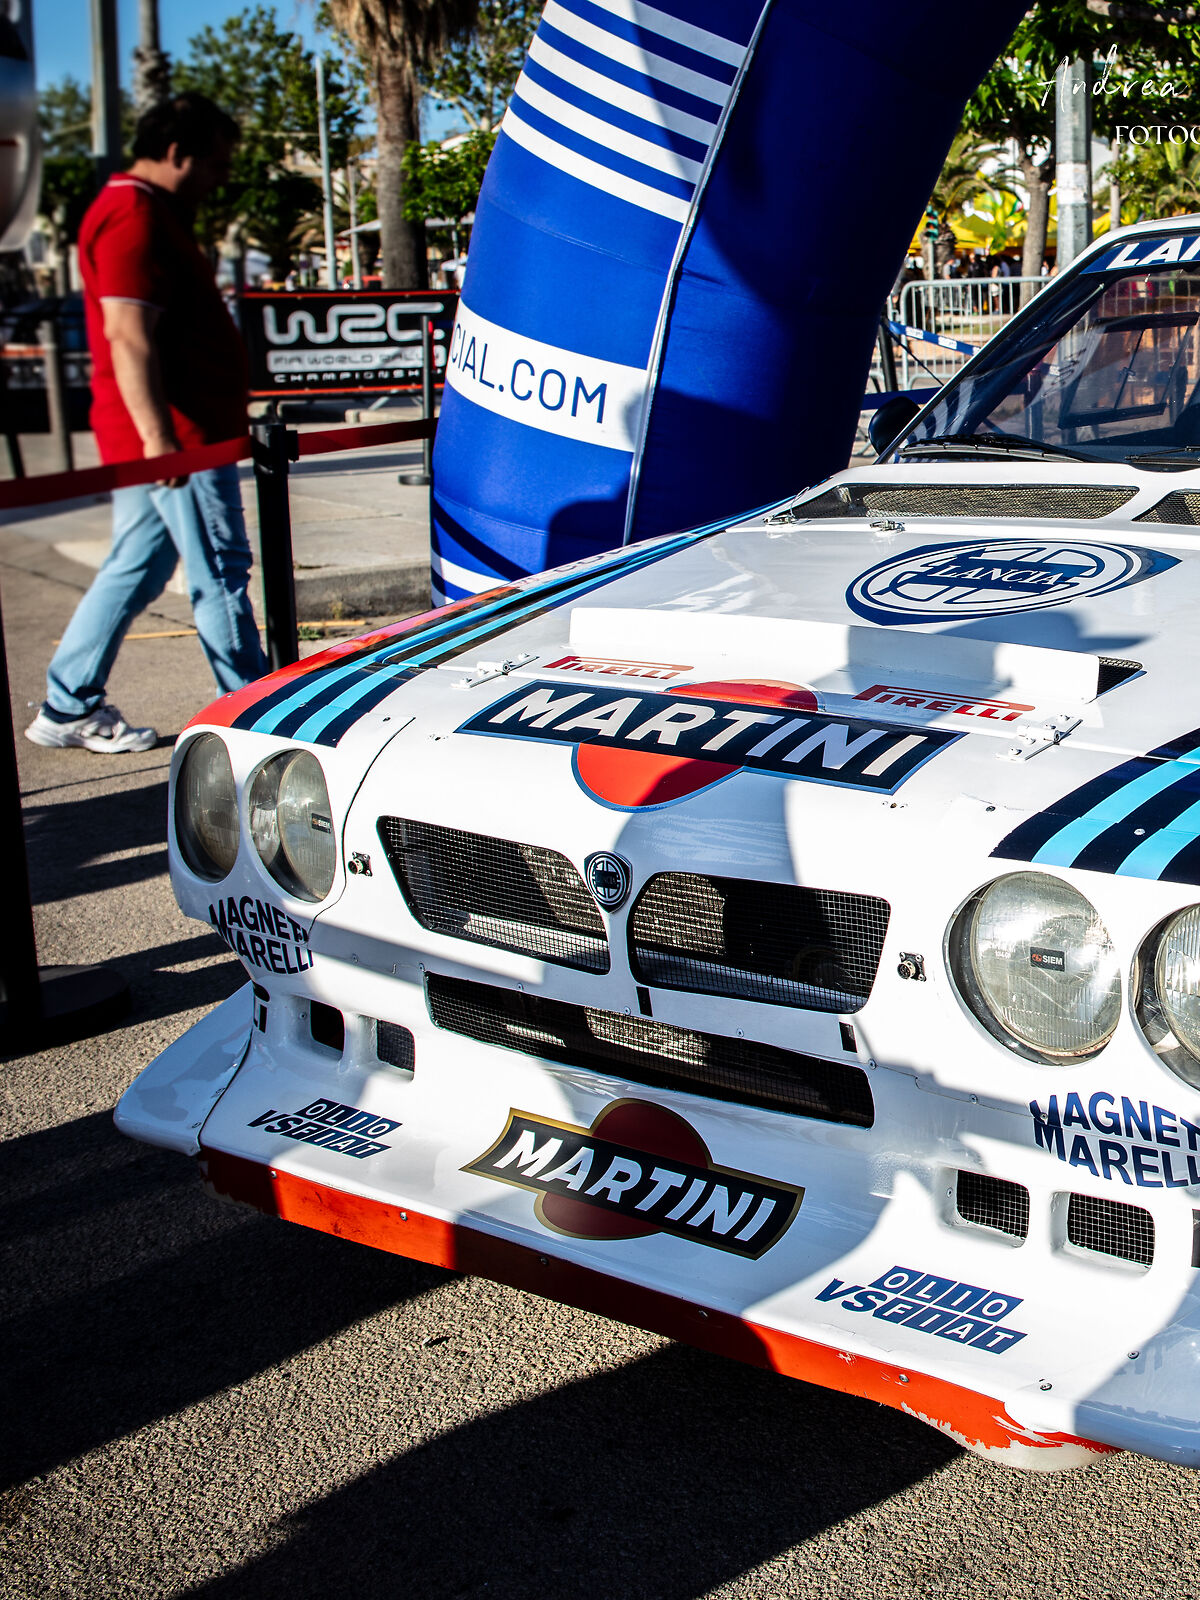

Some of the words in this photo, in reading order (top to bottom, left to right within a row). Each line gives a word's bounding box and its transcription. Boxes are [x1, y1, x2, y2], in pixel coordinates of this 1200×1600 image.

[931, 565, 1056, 586] LANCIA
[542, 656, 695, 680] PIRELLI
[852, 685, 1036, 722] PIRELLI
[487, 688, 928, 777] MARTINI
[208, 895, 309, 943] MAGNETI
[217, 922, 314, 975] MARELLI
[1042, 955, 1063, 966] SIEM
[305, 1103, 391, 1136] OLIO
[492, 1129, 777, 1242] MARTINI
[882, 1272, 1009, 1318] OLIO
